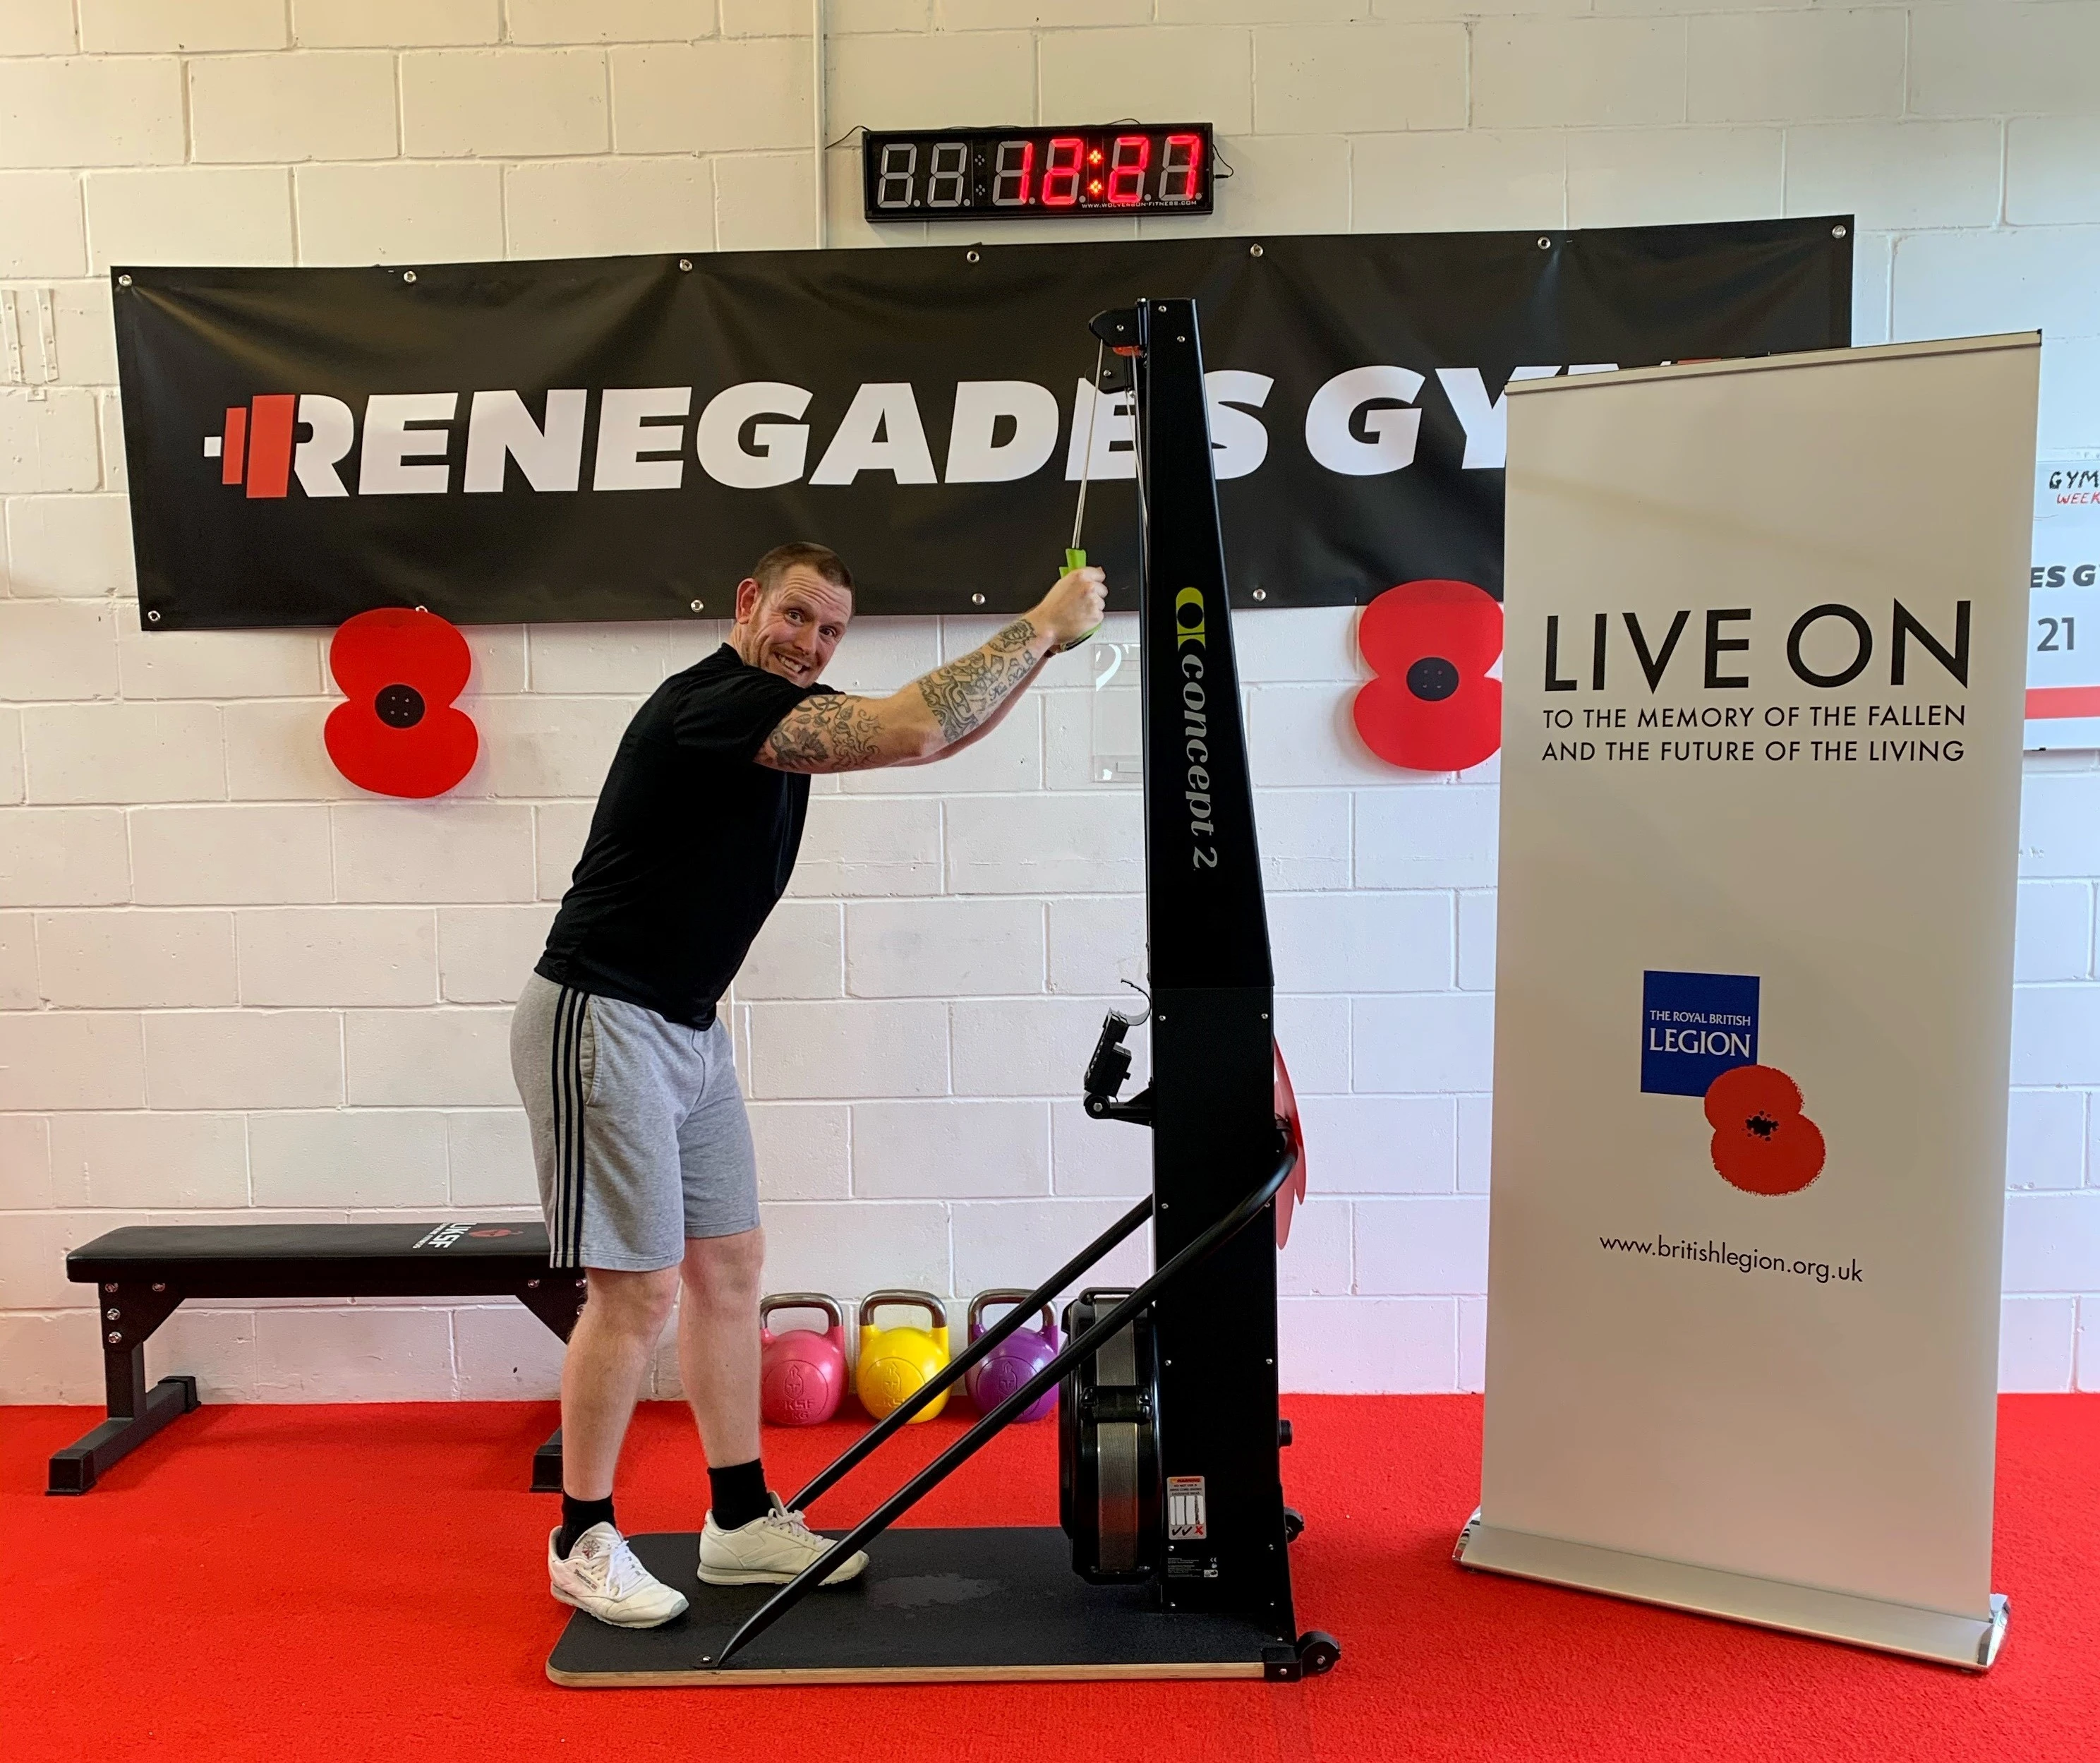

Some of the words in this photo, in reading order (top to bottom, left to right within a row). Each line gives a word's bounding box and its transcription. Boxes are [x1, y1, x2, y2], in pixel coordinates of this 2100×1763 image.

[1020, 134, 1200, 206] 12:27
[294, 369, 1274, 498] RENEGADES
[1305, 363, 1672, 476] GY
[2072, 564, 2100, 586] G
[1545, 608, 1753, 694] LIVE
[1787, 598, 1972, 690] ON
[1543, 710, 1574, 728] TO
[1583, 709, 1627, 728] THE
[1637, 708, 1754, 728] MEMORY
[1765, 707, 1800, 727] OF
[1810, 706, 1857, 726] THE
[1869, 705, 1966, 726] FALLEN
[1181, 654, 1214, 837] concept
[1543, 742, 1595, 762] AND
[1606, 742, 1650, 762] THE
[1661, 742, 1755, 762] FUTURE
[1766, 742, 1801, 762] OF
[1811, 741, 1858, 762] THE
[1870, 741, 1965, 762] LIVING
[1193, 847, 1219, 869] 2
[1650, 1010, 1671, 1021] THE
[1673, 1012, 1708, 1024] ROYAL
[1709, 1014, 1751, 1027] BRITISH
[1649, 1028, 1751, 1059] LEGION
[1599, 1234, 1864, 1284] www.britishlegion.org.uk
